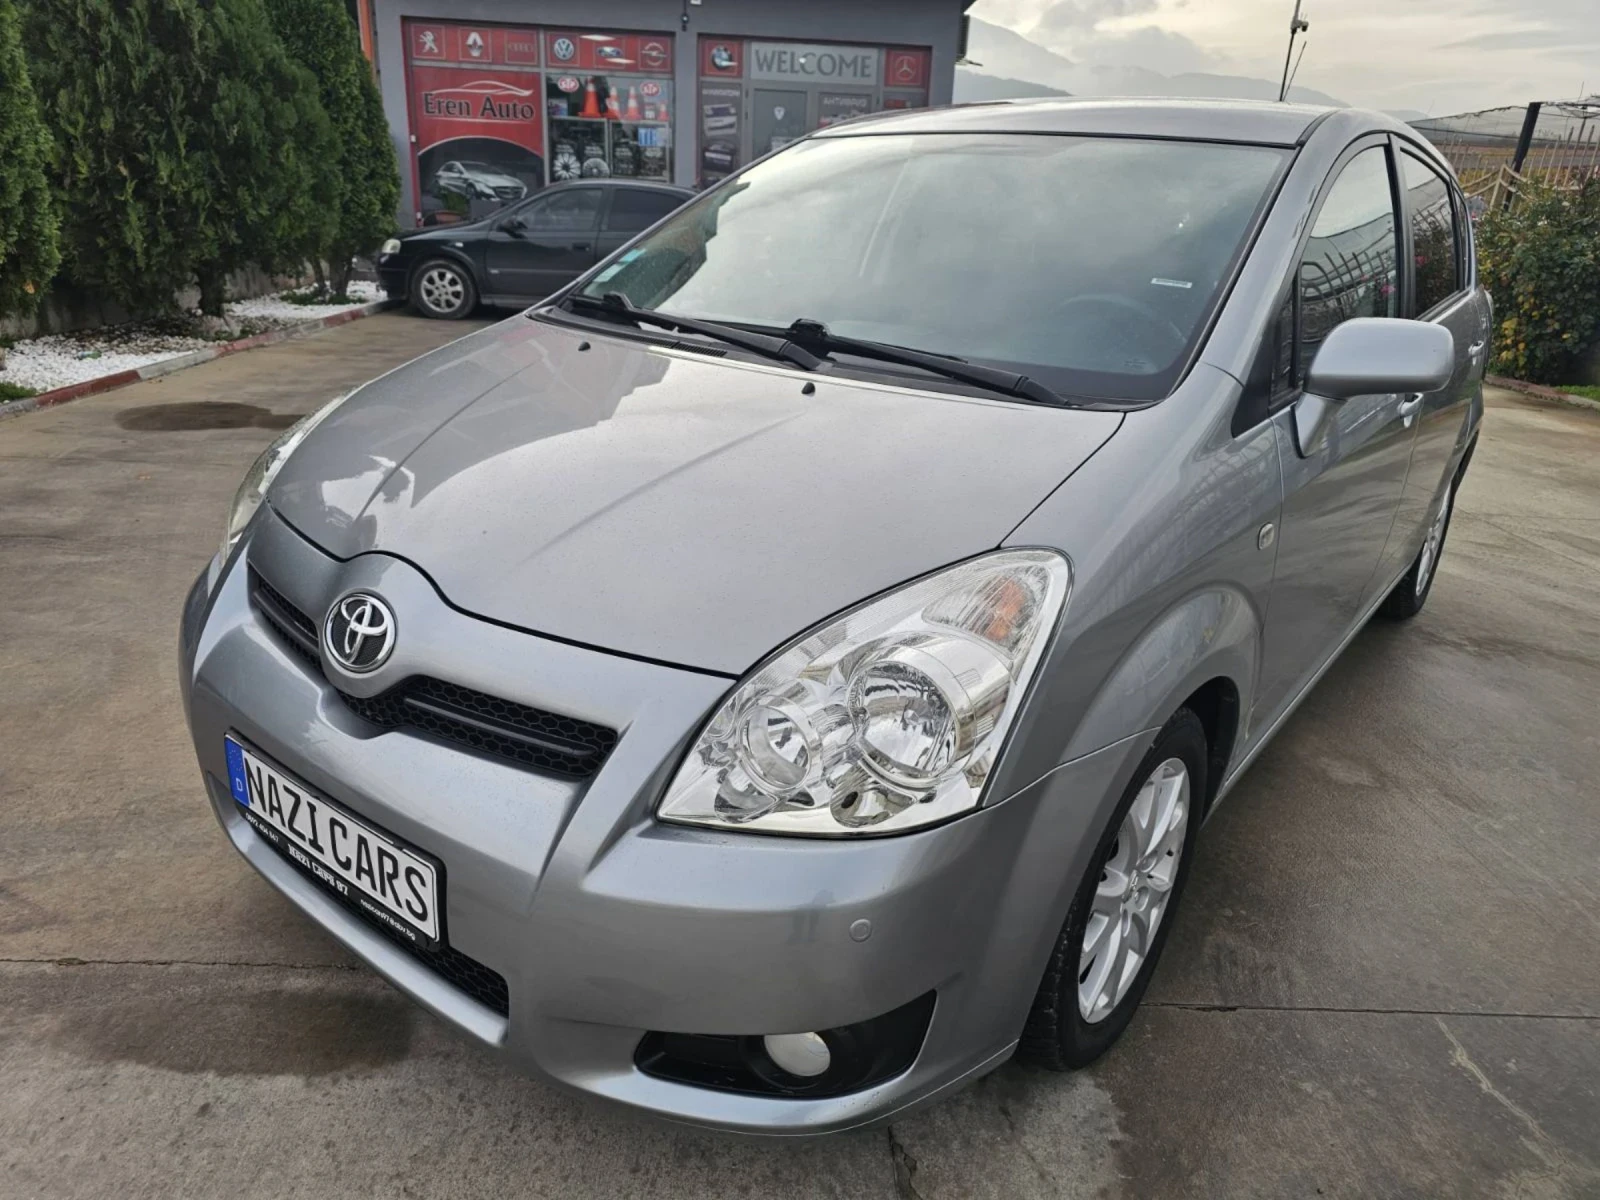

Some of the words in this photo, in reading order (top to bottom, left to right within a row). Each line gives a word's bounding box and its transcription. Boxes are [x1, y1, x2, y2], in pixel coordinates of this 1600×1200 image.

[755, 49, 872, 78] WELCOME
[423, 92, 471, 117] Eren
[479, 95, 534, 120] Auto
[235, 777, 243, 792] D
[244, 757, 325, 856] NAZI
[329, 816, 428, 922] CARS
